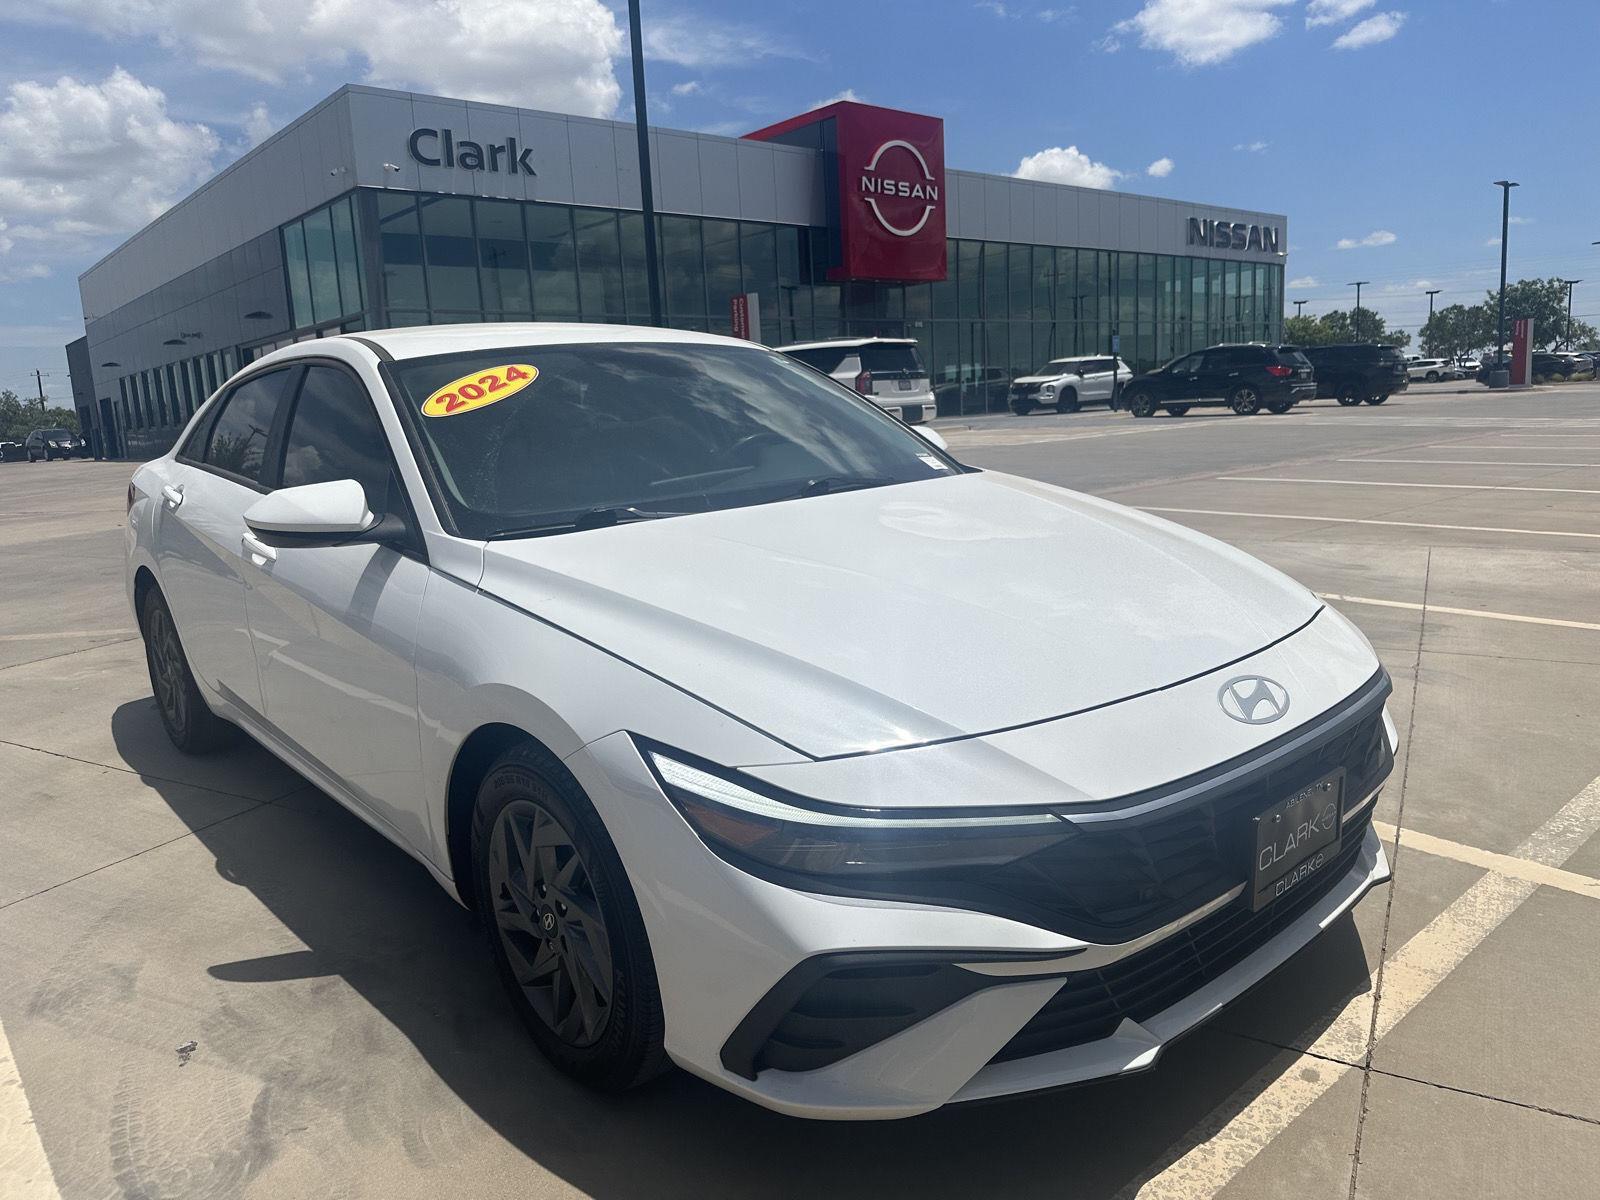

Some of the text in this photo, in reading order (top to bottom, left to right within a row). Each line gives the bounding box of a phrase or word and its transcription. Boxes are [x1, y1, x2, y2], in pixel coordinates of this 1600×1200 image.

[407, 128, 537, 176] Clark
[861, 175, 938, 201] NISSAN
[1186, 217, 1279, 253] NISSAN
[435, 366, 529, 413] 2024
[1259, 813, 1320, 871] CLARK
